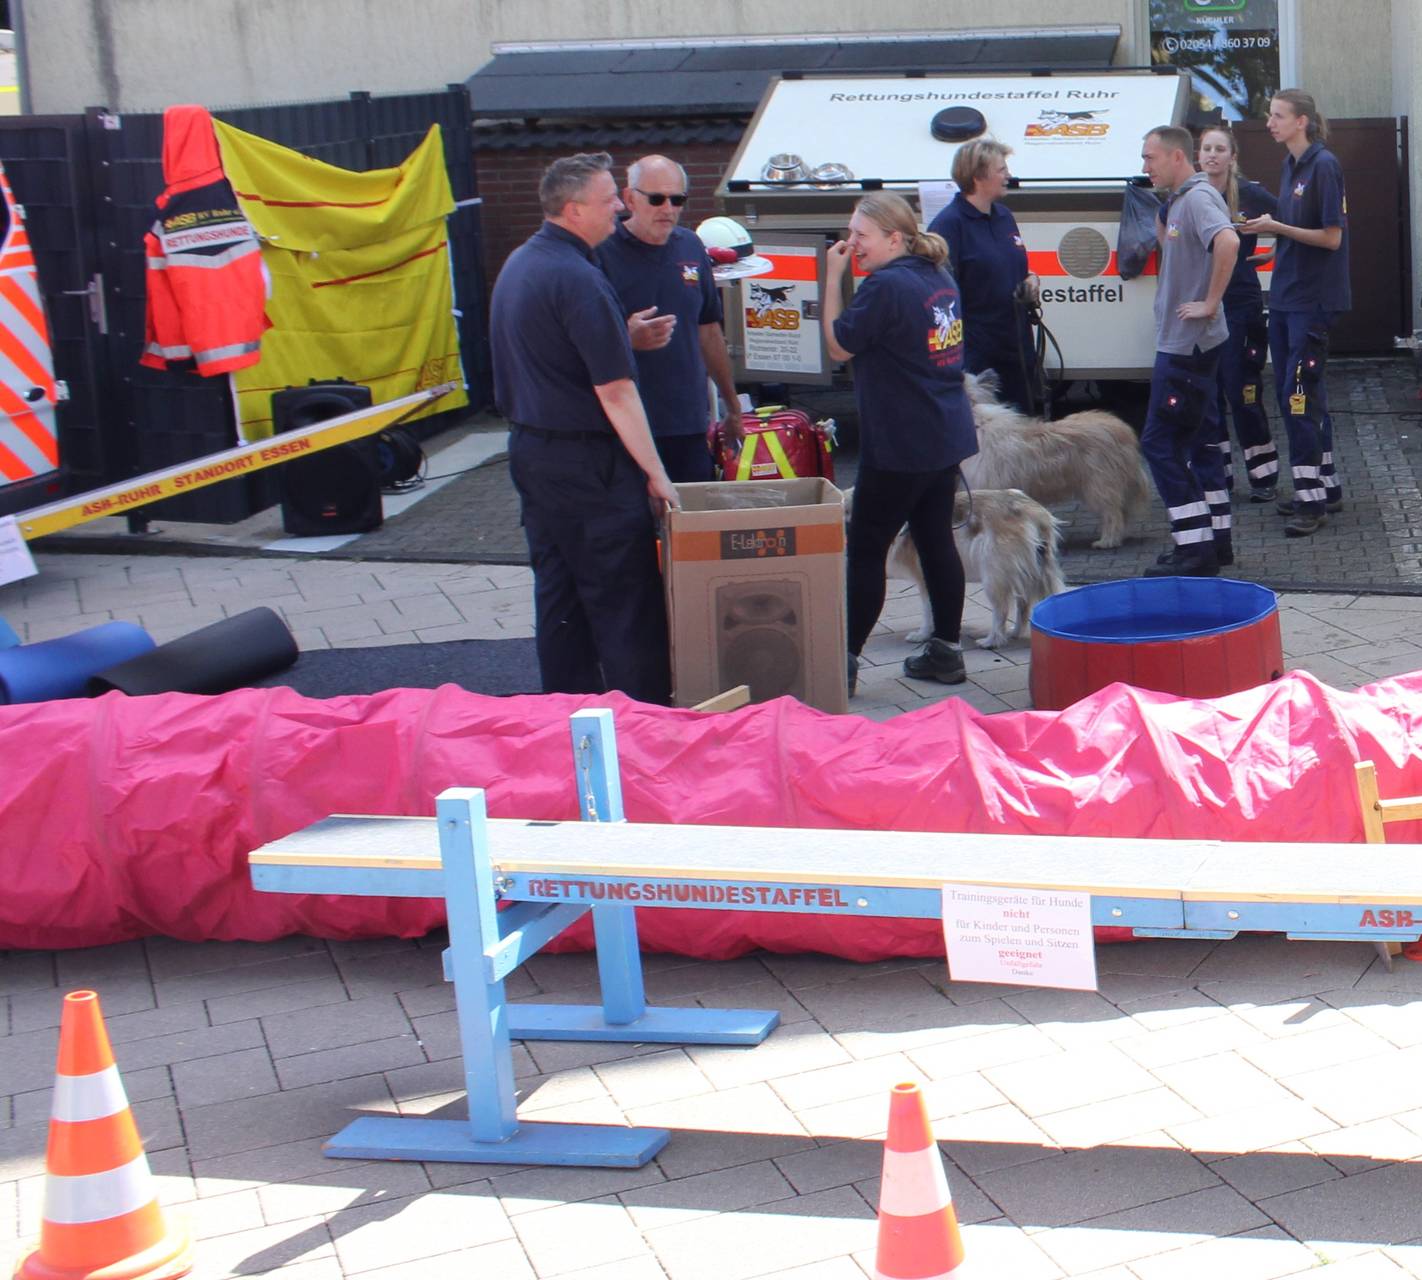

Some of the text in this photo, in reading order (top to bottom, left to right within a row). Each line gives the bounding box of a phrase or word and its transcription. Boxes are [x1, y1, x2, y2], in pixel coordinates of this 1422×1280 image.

[1180, 39, 1211, 50] 02054
[1242, 38, 1255, 48] 37
[1257, 37, 1271, 48] 09
[829, 90, 1120, 102] Rettungshundestaffel Ruhr
[1040, 284, 1124, 303] estaffel
[82, 438, 311, 517] ASB-RUHR STANDORT ESSEN
[528, 879, 849, 908] RETTUNGSHUNDESTAFFEL
[950, 889, 1084, 908] Trainingsgeräte für Hunde
[1003, 909, 1030, 919] nicht
[955, 919, 1080, 936] für Kinder und Personen
[959, 934, 1079, 949] zum Spielen und Sitzen
[998, 949, 1042, 960] geeignet
